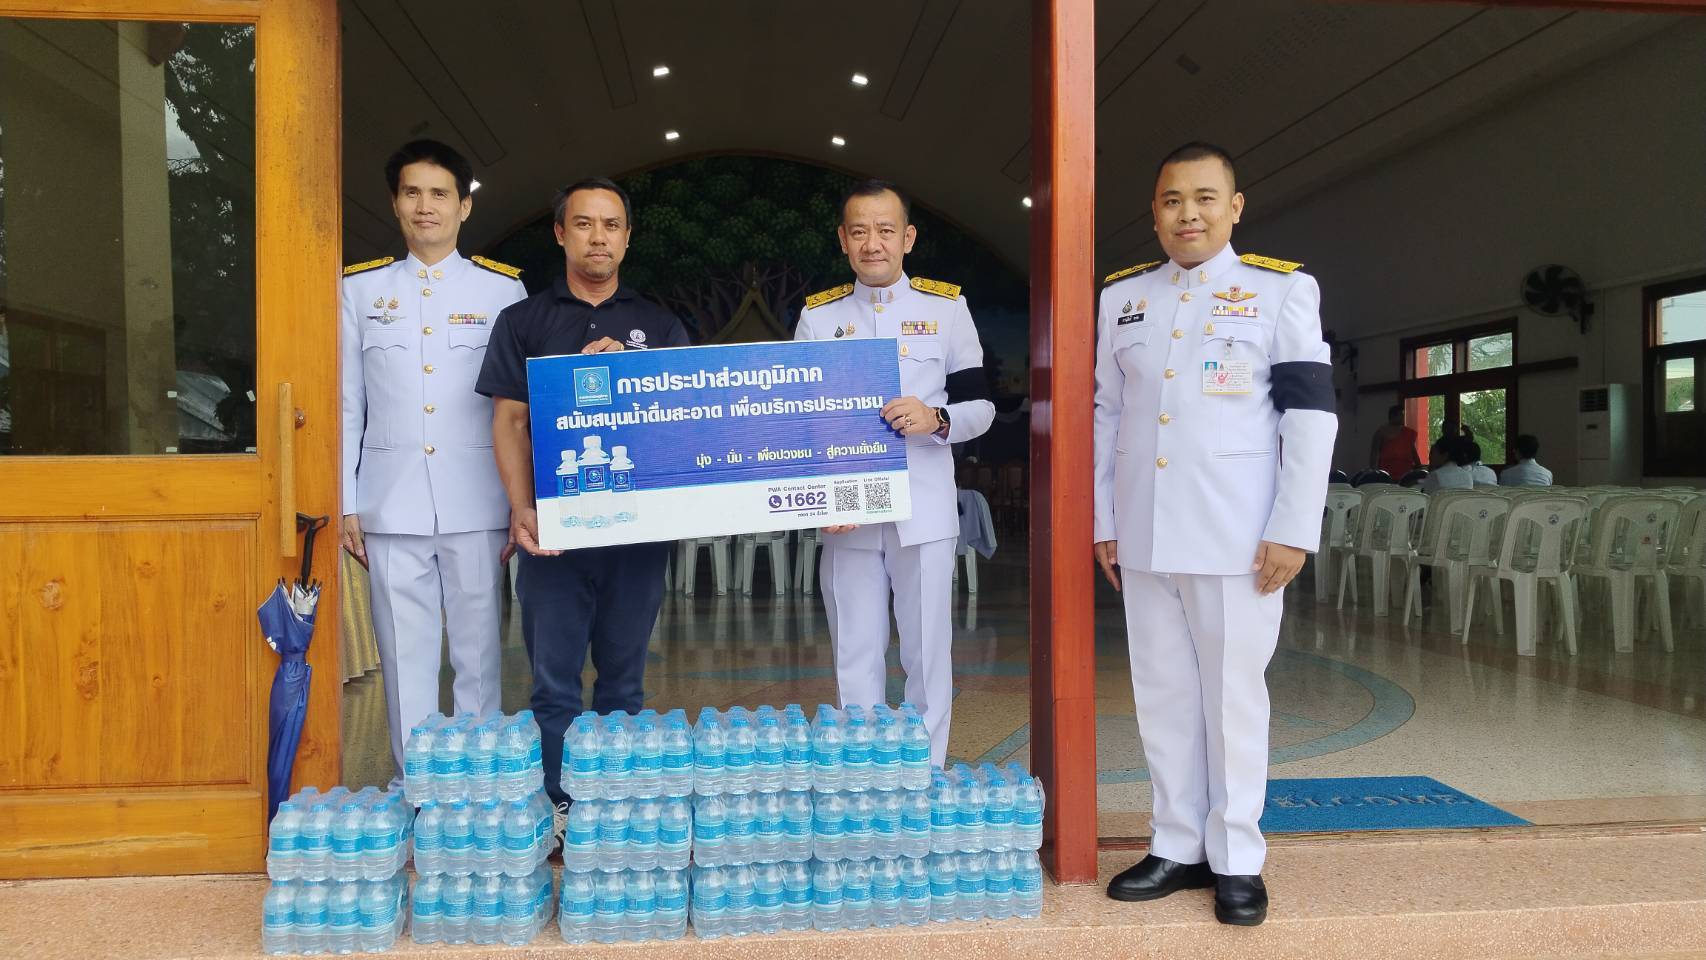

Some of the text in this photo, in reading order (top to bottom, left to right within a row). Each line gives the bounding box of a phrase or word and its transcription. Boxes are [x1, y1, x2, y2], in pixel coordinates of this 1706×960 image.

[617, 364, 823, 395] การประปาส่วนภูมิภาค
[556, 395, 884, 431] สนับสนุนน้ำดื่มสะอาด เพื่อบริการประชาชน
[696, 453, 712, 469] มุ่ง
[727, 449, 743, 464] มั่น
[757, 446, 812, 462] เพื่อปวงชน
[826, 440, 887, 460] สู่ความยั่งยืน
[784, 491, 827, 508] 1662
